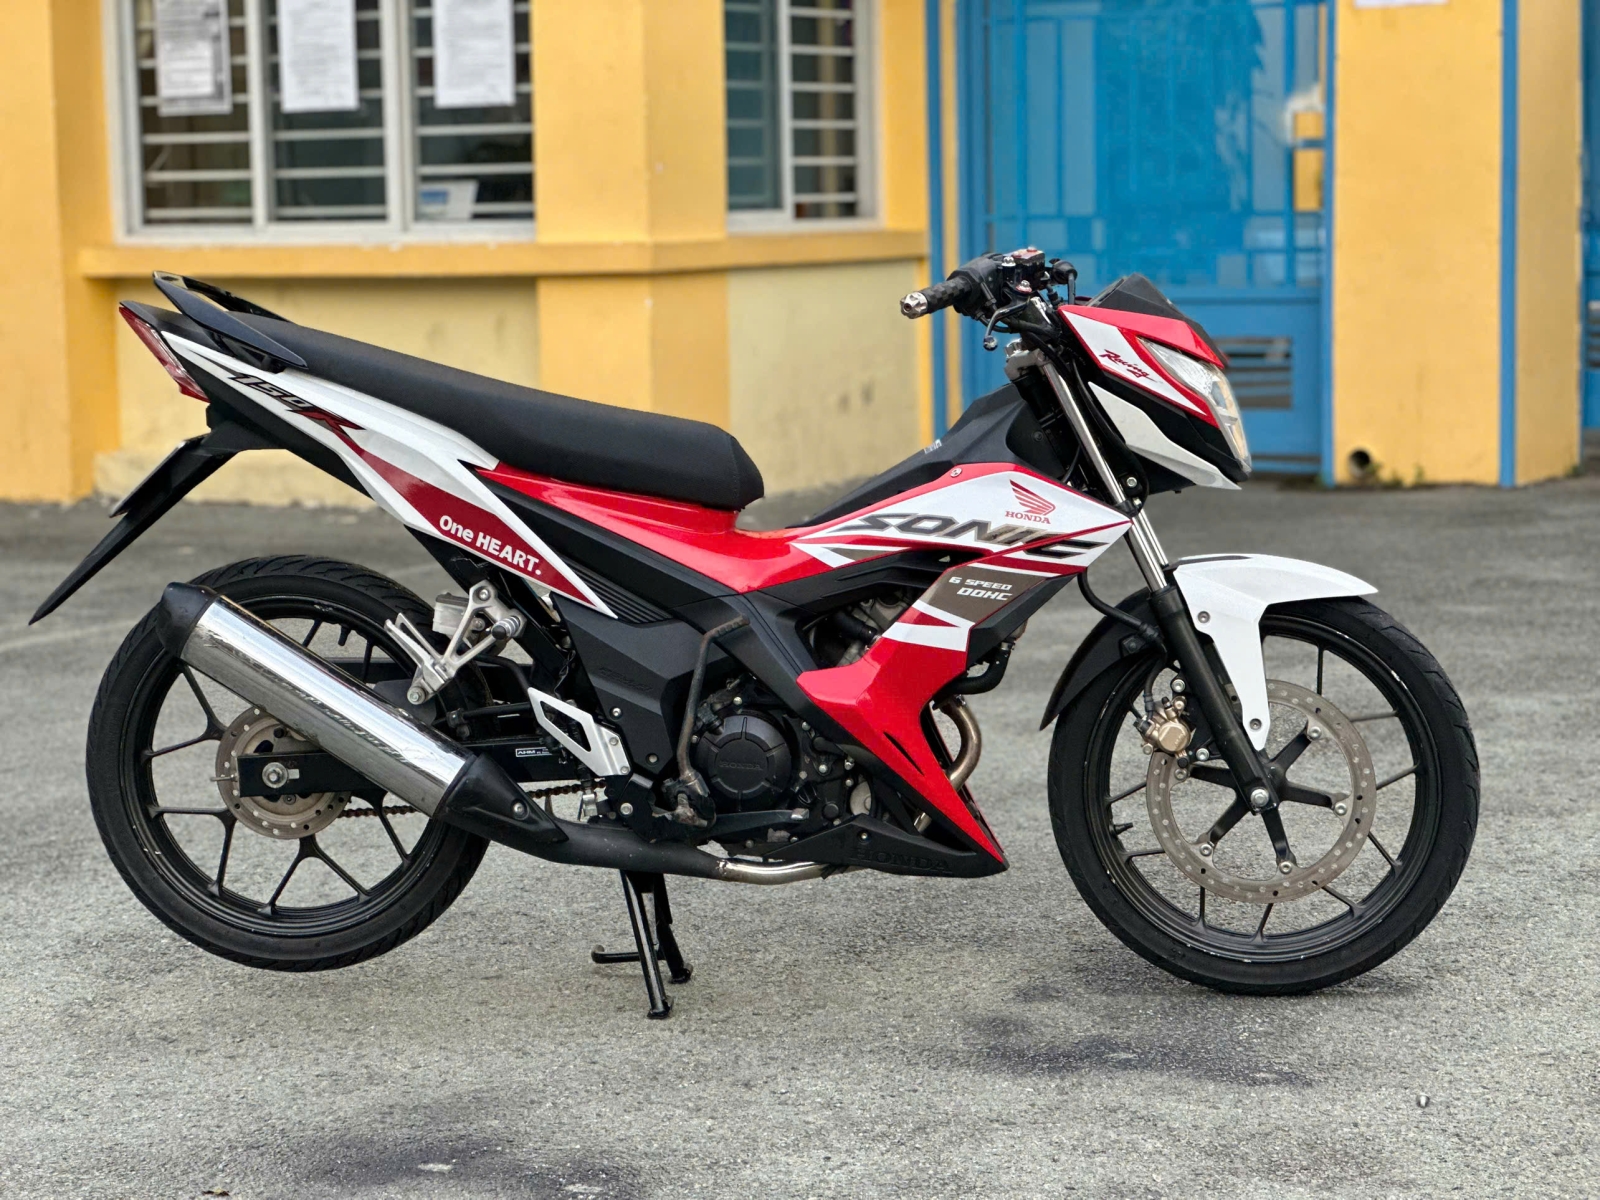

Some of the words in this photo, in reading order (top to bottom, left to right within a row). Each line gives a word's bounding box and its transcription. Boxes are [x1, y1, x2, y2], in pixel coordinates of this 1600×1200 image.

[1099, 349, 1158, 382] Racing
[1005, 510, 1051, 525] HONDA
[439, 515, 474, 542] One
[475, 531, 541, 575] HEART.
[828, 512, 1109, 560] SONIC
[948, 576, 963, 584] 6
[964, 579, 1013, 591] SPEED
[956, 587, 1013, 601] DOHC
